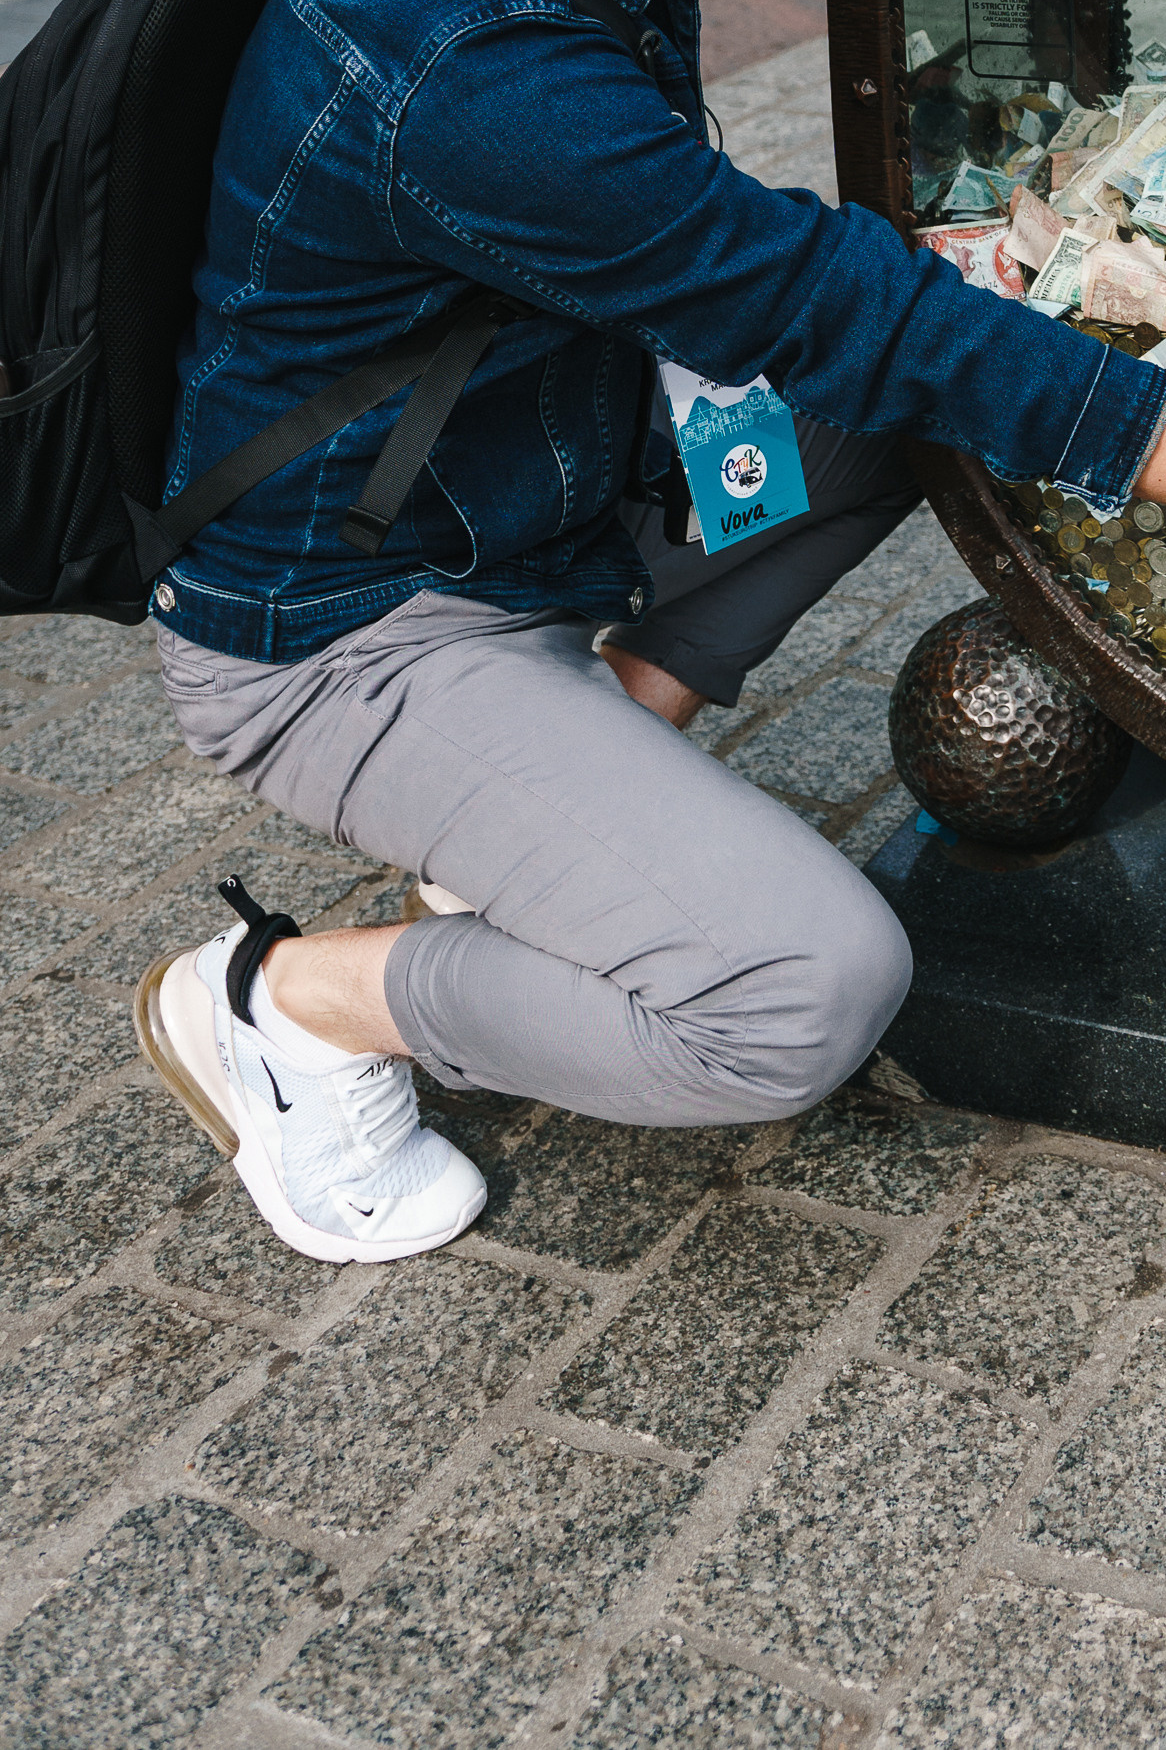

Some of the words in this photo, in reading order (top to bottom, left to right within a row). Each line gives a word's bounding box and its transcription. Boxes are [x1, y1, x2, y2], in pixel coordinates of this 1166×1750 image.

[981, 2, 1015, 11] STRICTLY
[1055, 112, 1085, 144] 100
[720, 503, 768, 534] Vova
